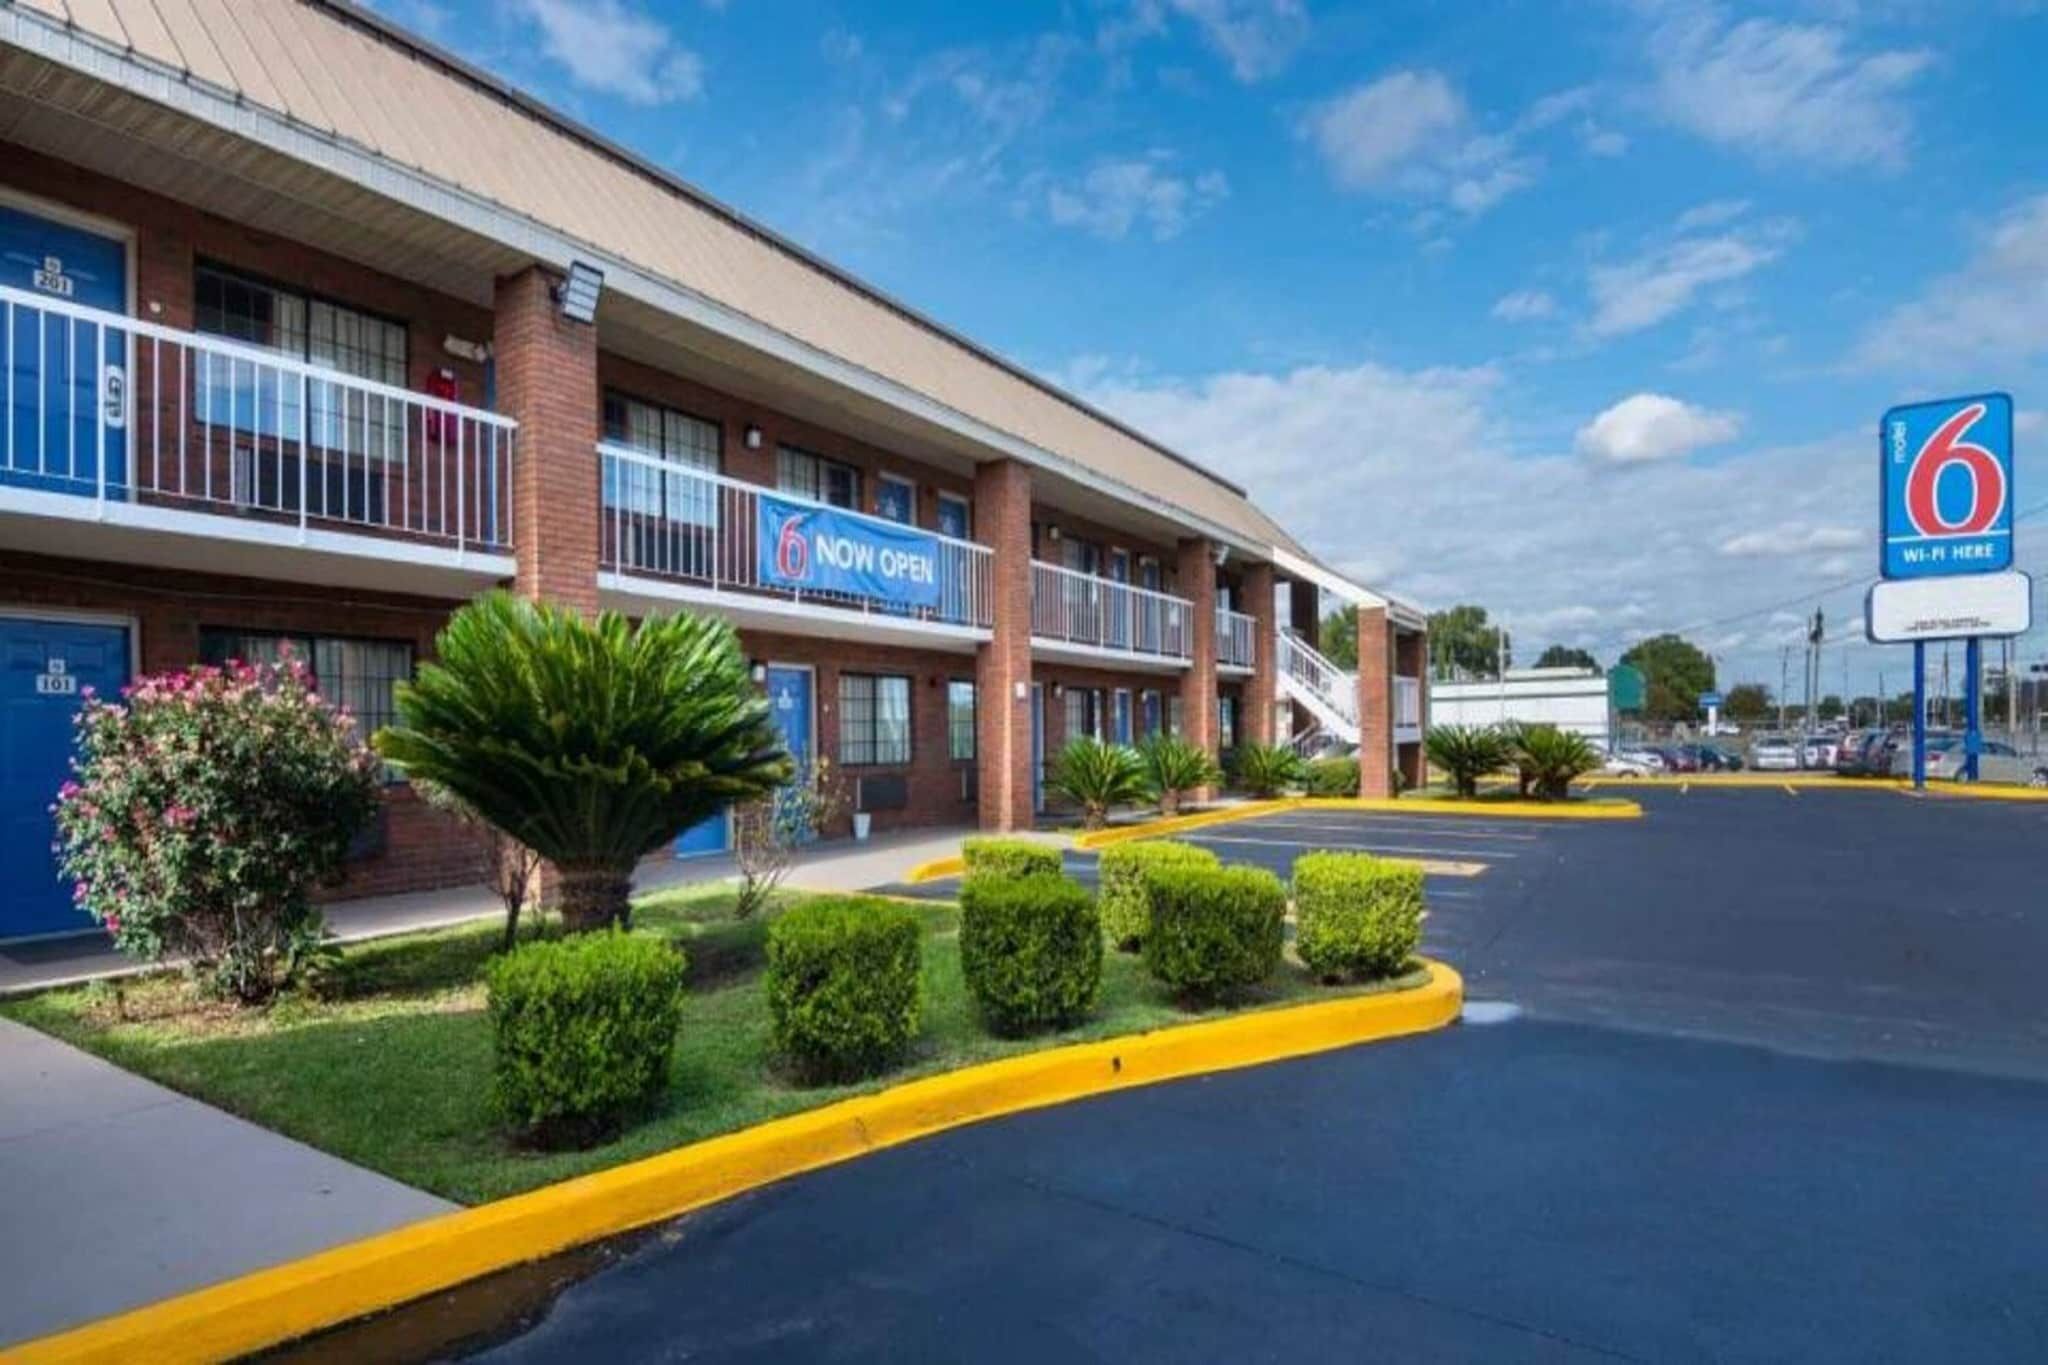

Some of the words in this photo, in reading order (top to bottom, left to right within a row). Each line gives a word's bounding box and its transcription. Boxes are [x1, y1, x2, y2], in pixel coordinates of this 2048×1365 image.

[39, 271, 69, 292] 201
[1905, 403, 2006, 537] 6
[777, 514, 807, 580] 6
[816, 534, 874, 573] NOW
[879, 548, 934, 584] OPEN
[1903, 547, 1945, 563] WI-FI
[1952, 543, 1994, 560] HERE
[42, 678, 70, 690] 101
